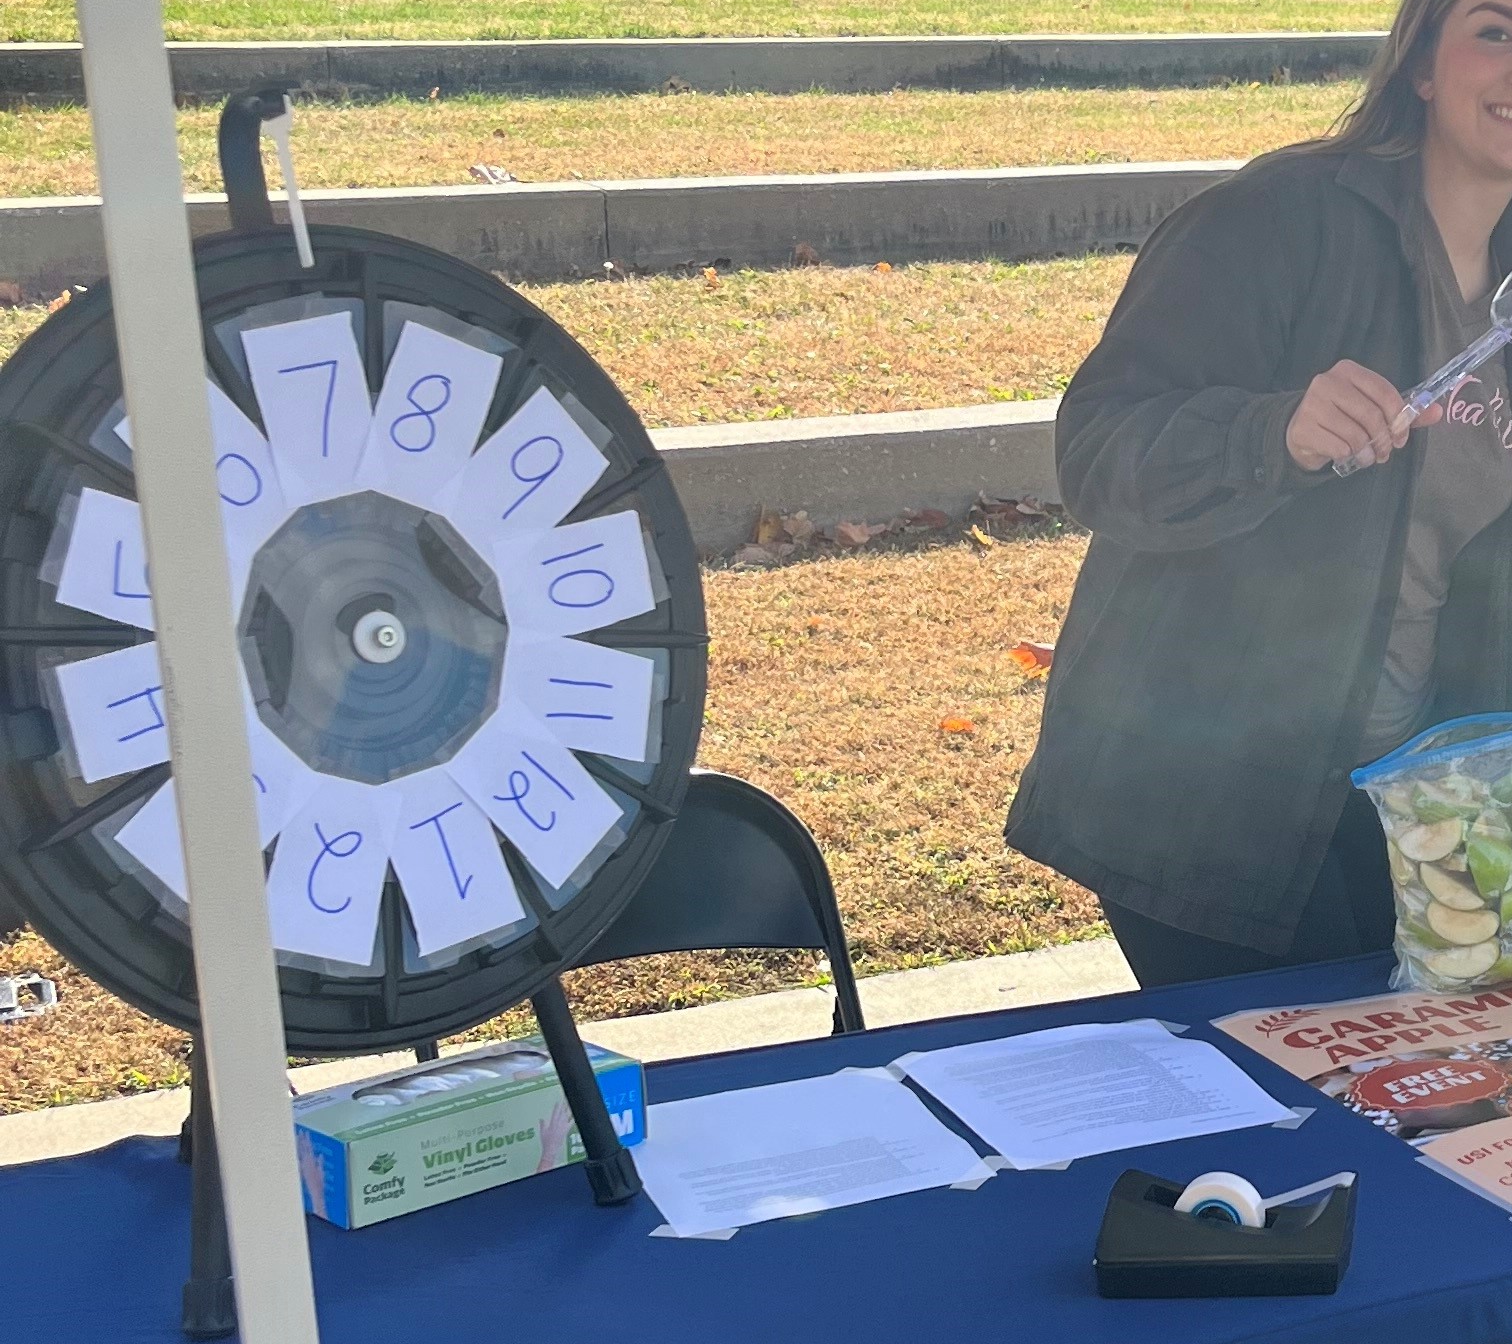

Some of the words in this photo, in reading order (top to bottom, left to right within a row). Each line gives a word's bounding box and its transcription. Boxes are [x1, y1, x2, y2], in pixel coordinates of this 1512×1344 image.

[278, 360, 338, 457] 7
[390, 374, 451, 452] 8
[503, 436, 563, 519] 9
[541, 543, 615, 608] 10
[546, 678, 613, 720] 11
[493, 750, 575, 832] 12
[307, 821, 363, 914] 2
[409, 800, 474, 901] 1
[1325, 1014, 1502, 1065] APPLE
[1382, 1063, 1462, 1094] FREE
[1391, 1068, 1490, 1106] EVENT
[422, 1142, 473, 1170] Vinyl
[475, 1126, 537, 1155] Gloves
[1456, 1146, 1493, 1167] USI
[362, 1174, 406, 1197] Comfy
[362, 1186, 407, 1207] Package
